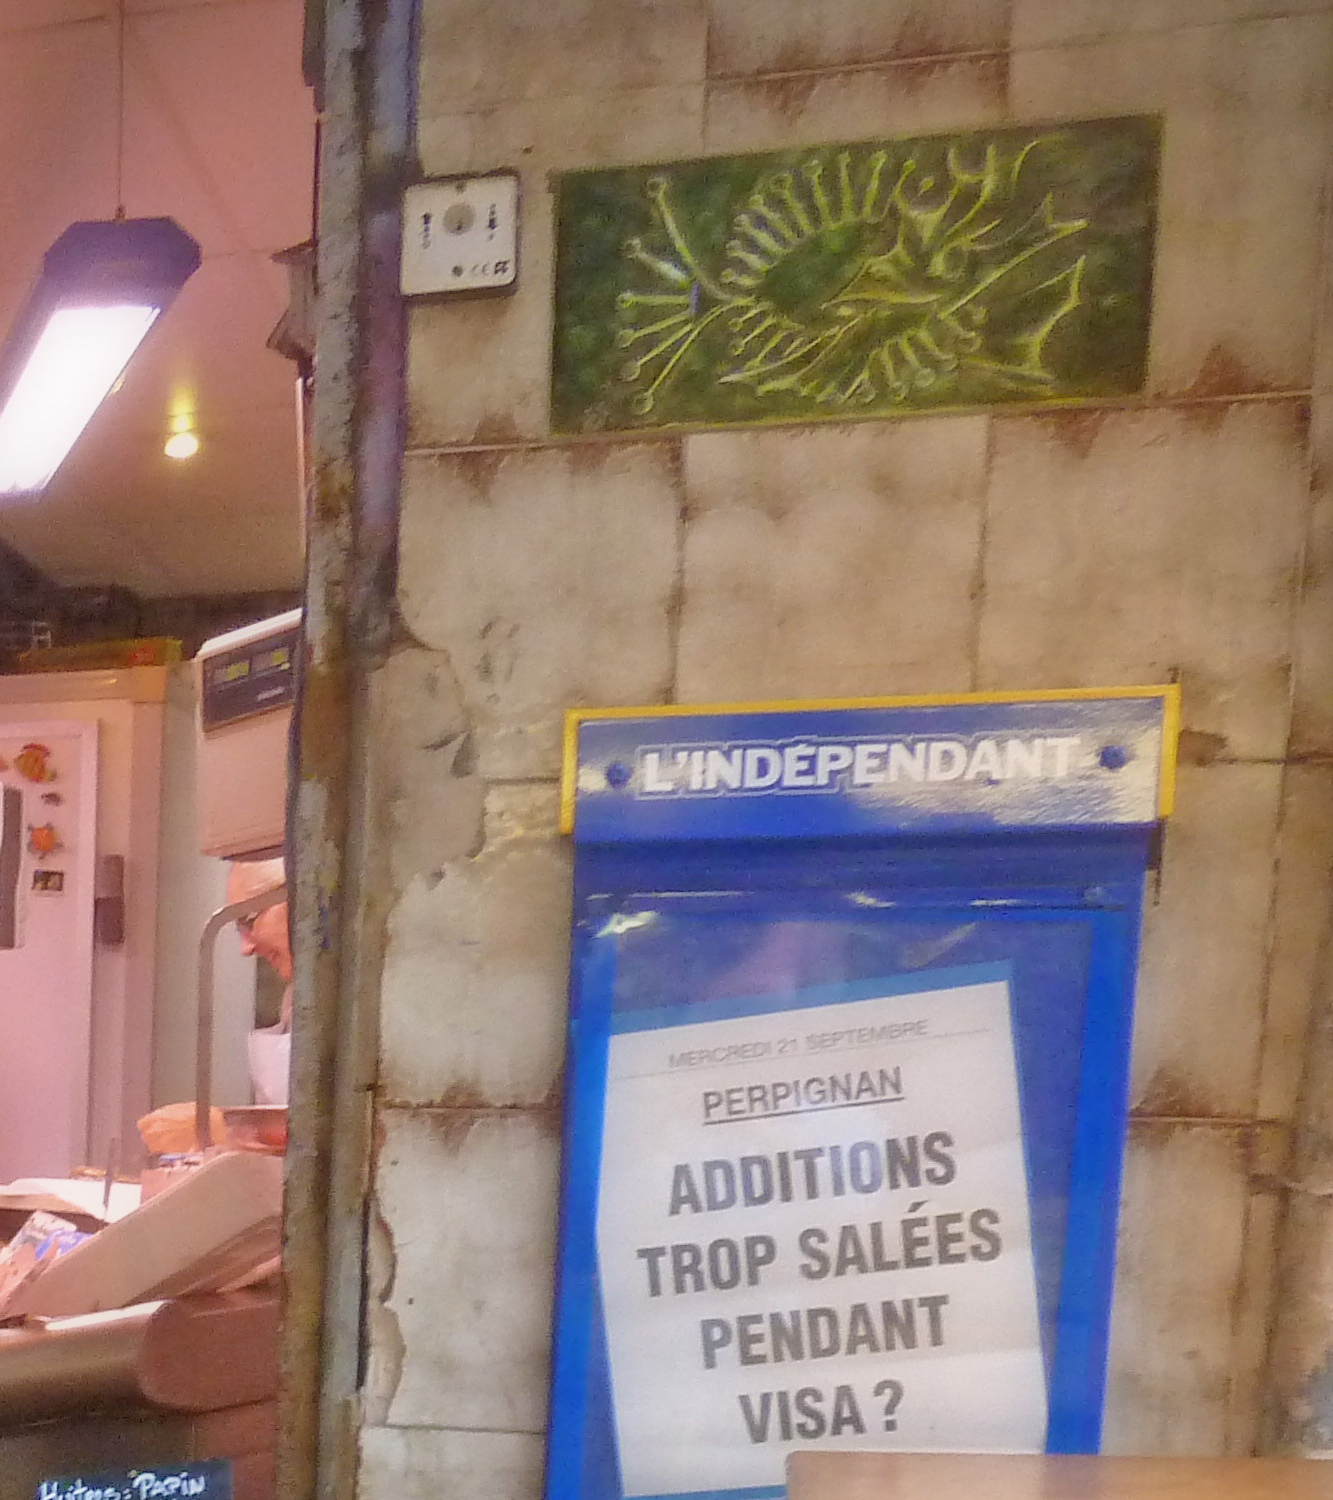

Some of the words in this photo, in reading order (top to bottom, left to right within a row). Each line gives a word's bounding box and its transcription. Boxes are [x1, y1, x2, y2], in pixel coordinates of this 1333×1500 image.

[642, 736, 1082, 793] L'INDÉPENDANT
[668, 1041, 771, 1069] MERCREDI
[777, 1036, 798, 1054] 21
[806, 1019, 928, 1051] SEPTEMBRE
[703, 1066, 903, 1120] PERPIGNAN
[669, 1130, 957, 1217] ADDITIONS
[636, 1234, 777, 1299] TROP
[798, 1199, 1003, 1281] SALÉES
[700, 1294, 950, 1370] PENDANT
[738, 1384, 867, 1445] VISA
